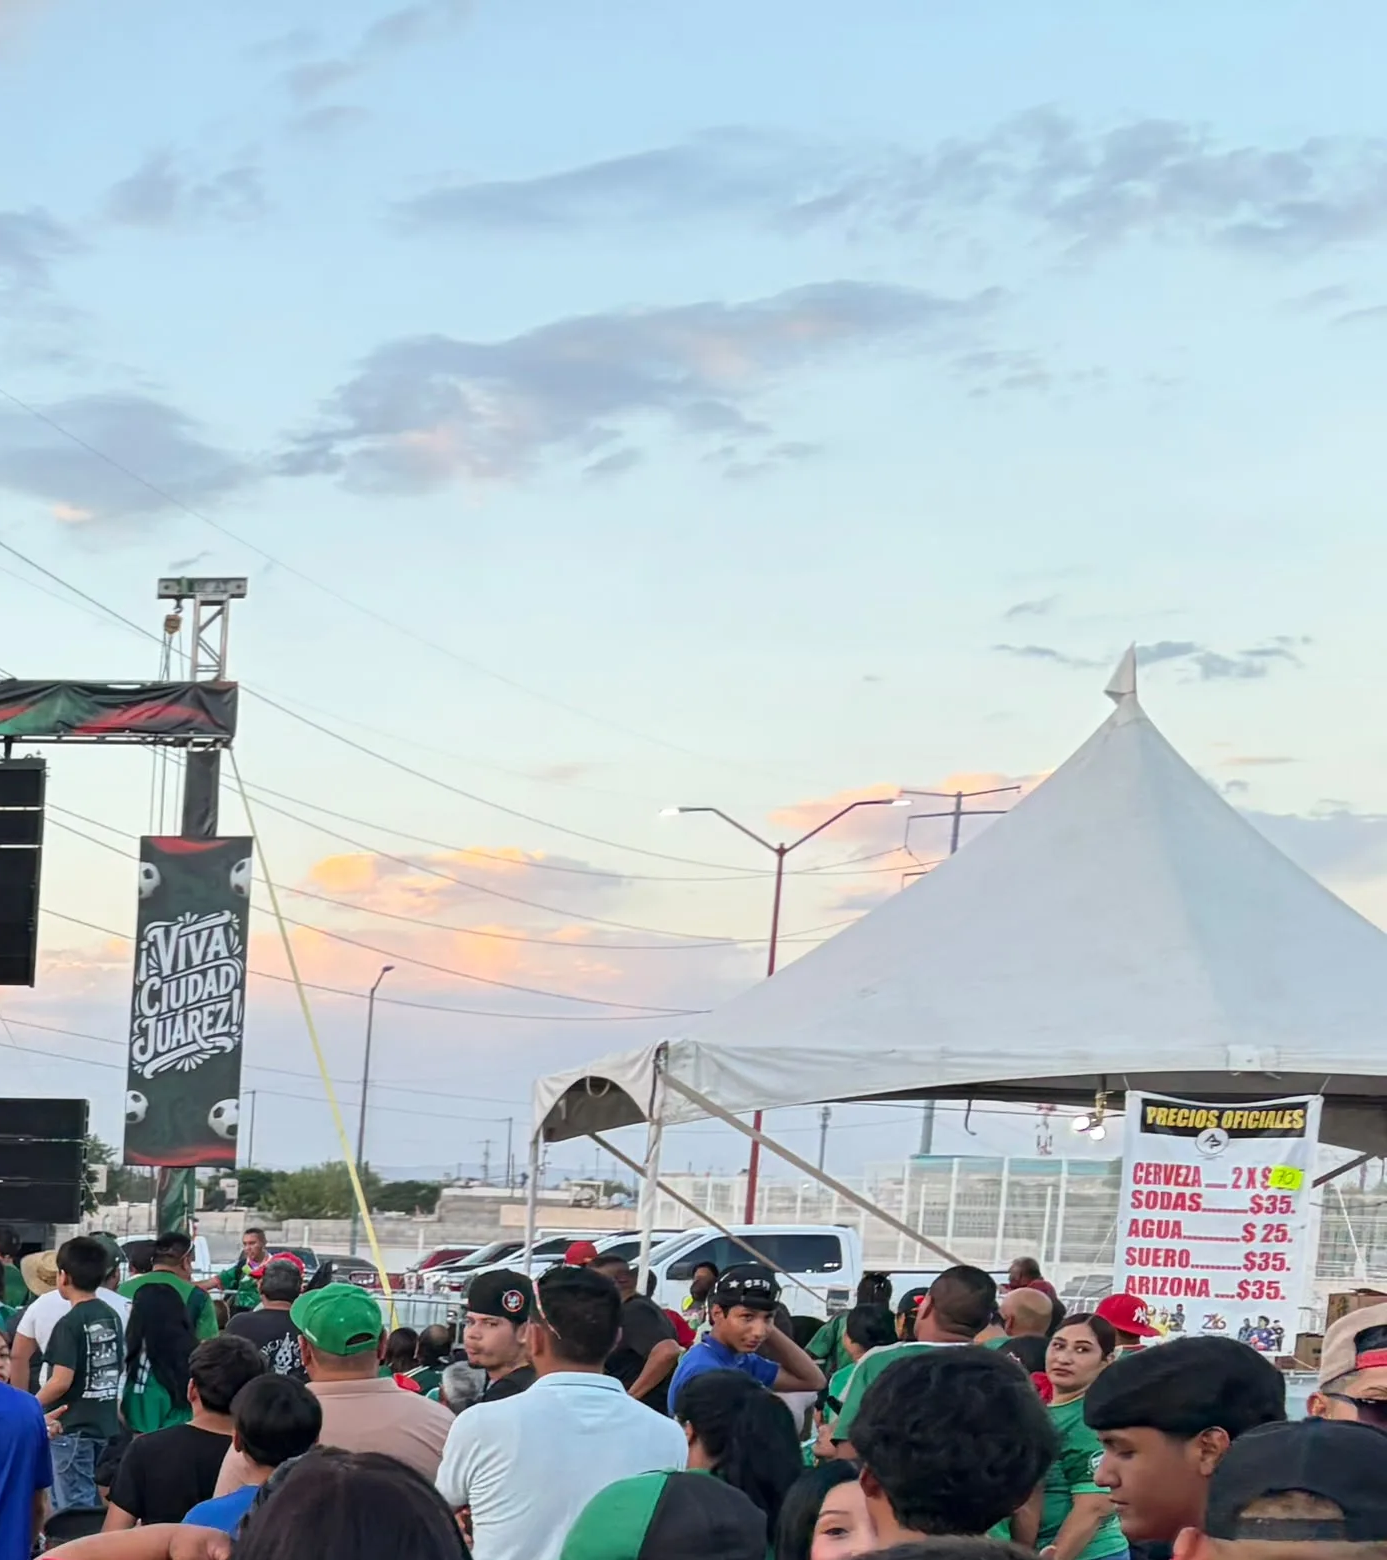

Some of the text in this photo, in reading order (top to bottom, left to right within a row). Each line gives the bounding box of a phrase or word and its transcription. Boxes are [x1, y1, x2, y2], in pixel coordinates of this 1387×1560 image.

[140, 966, 236, 1017] CIUDAD
[132, 988, 241, 1062] JUÁREZ!
[1146, 1106, 1305, 1129] PRECIOS OFICIALES
[1132, 1161, 1202, 1188] CERVEZA
[1231, 1167, 1242, 1189] 2
[1246, 1167, 1257, 1189] X
[1130, 1190, 1203, 1212] SODAS
[1127, 1219, 1183, 1239] AGUA
[1125, 1246, 1191, 1268] SUERO
[1125, 1275, 1210, 1298] ARIZONA
